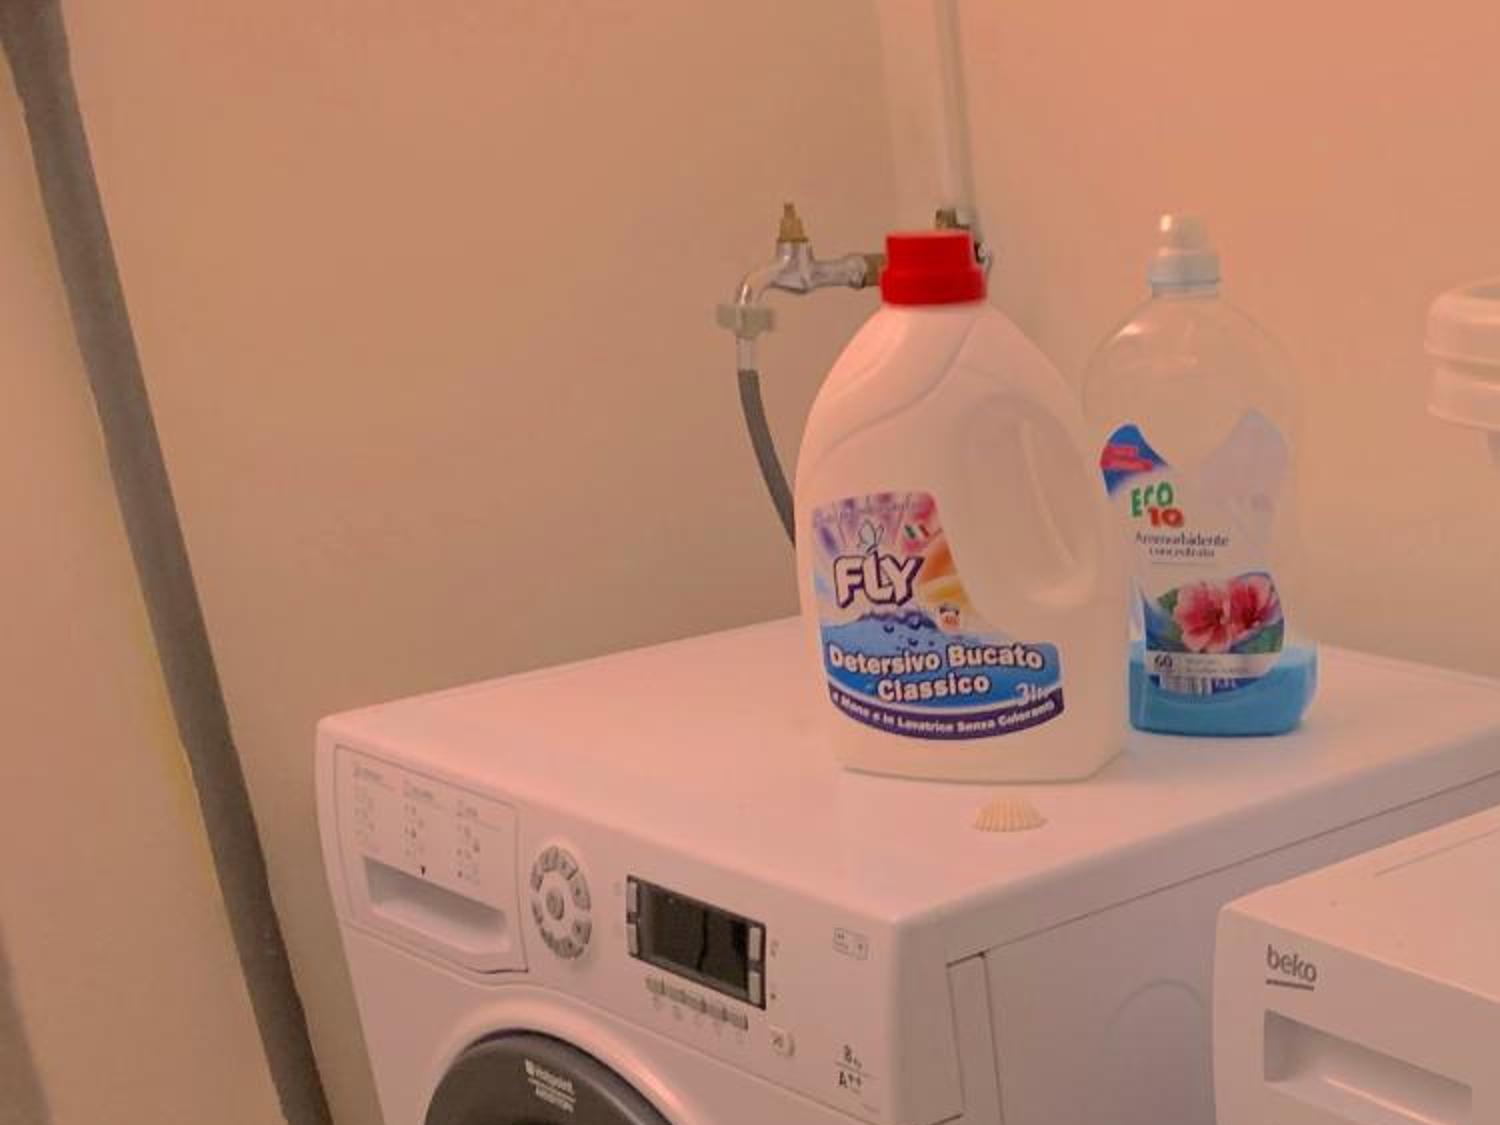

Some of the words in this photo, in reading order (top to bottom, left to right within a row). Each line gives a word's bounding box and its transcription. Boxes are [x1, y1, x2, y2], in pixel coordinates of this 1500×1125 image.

[1131, 481, 1173, 518] ECO
[1147, 506, 1184, 528] 10
[833, 548, 925, 609] FLY
[828, 644, 942, 676] Detersivo
[946, 643, 1045, 669] Bucato
[877, 672, 991, 702] Classico
[1265, 944, 1318, 984] beko
